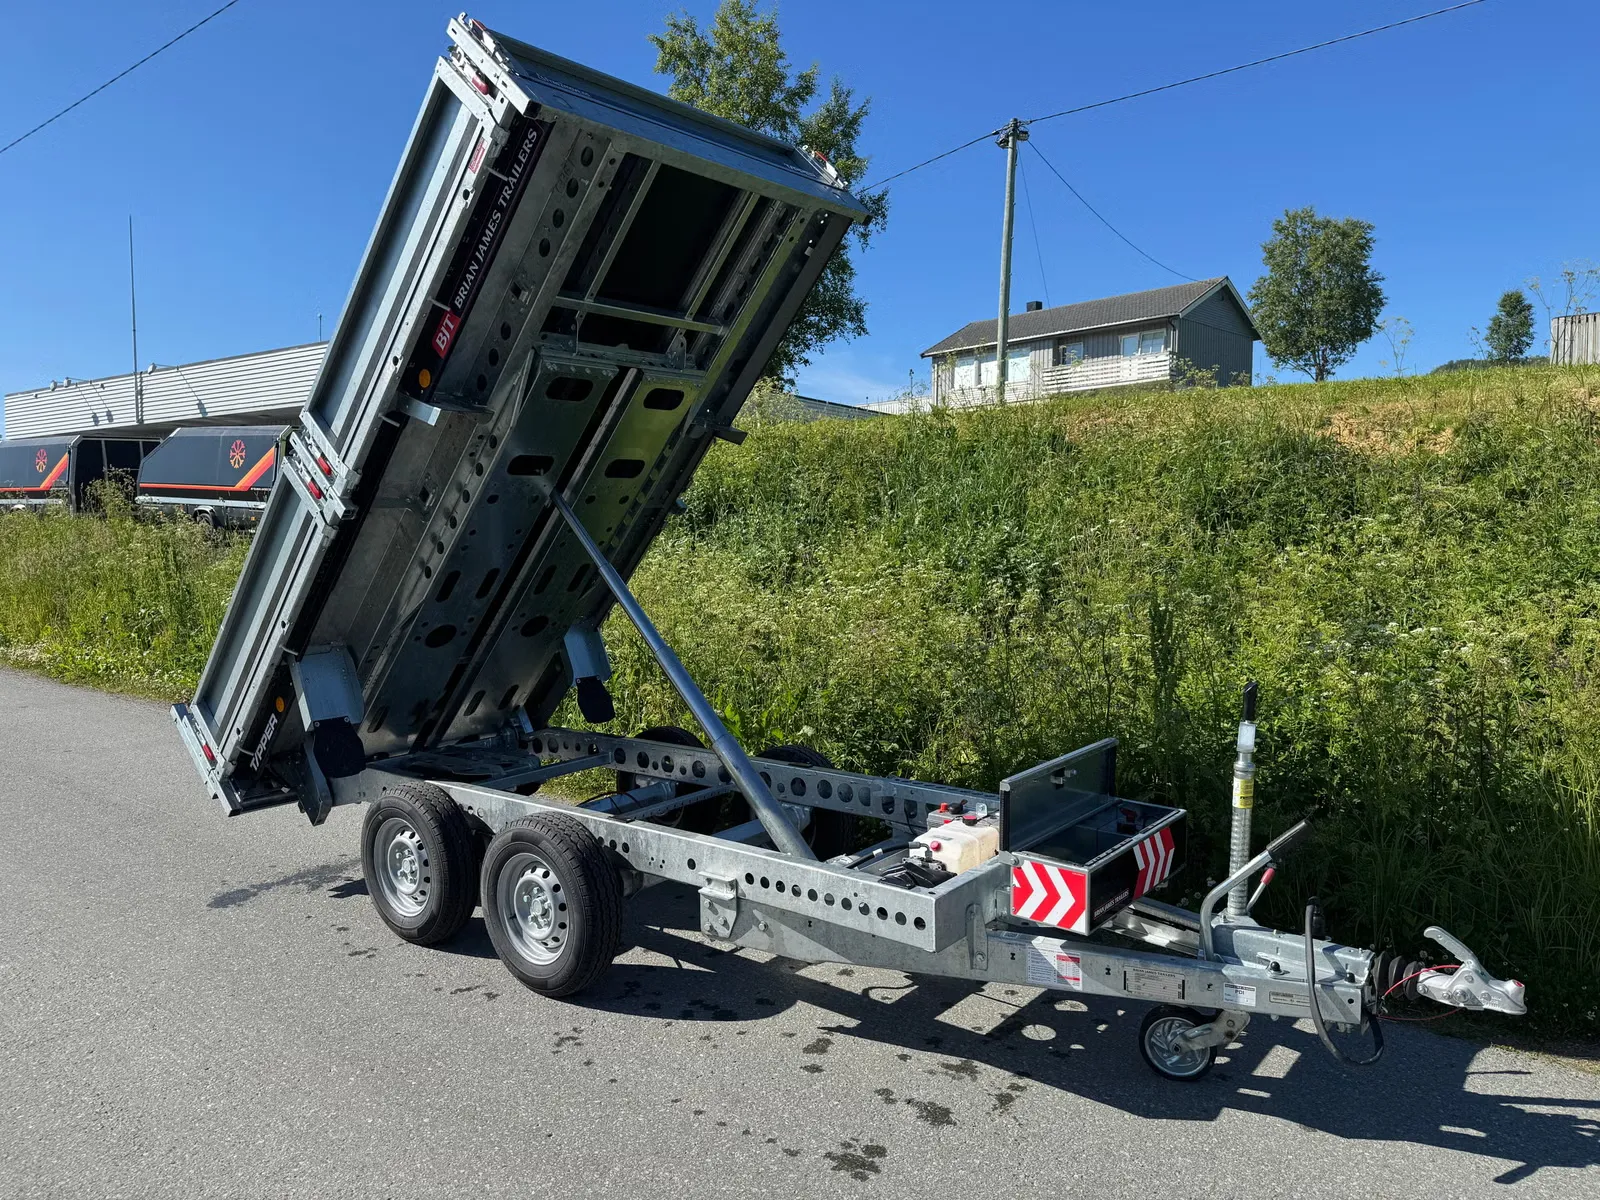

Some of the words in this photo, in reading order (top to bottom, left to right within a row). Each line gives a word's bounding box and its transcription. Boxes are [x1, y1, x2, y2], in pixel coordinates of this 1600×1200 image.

[435, 313, 455, 351] BJT
[454, 260, 479, 309] BRIAN
[474, 209, 501, 262] JAMES
[498, 128, 538, 209] TRAILERS
[250, 713, 278, 771] TIPPER
